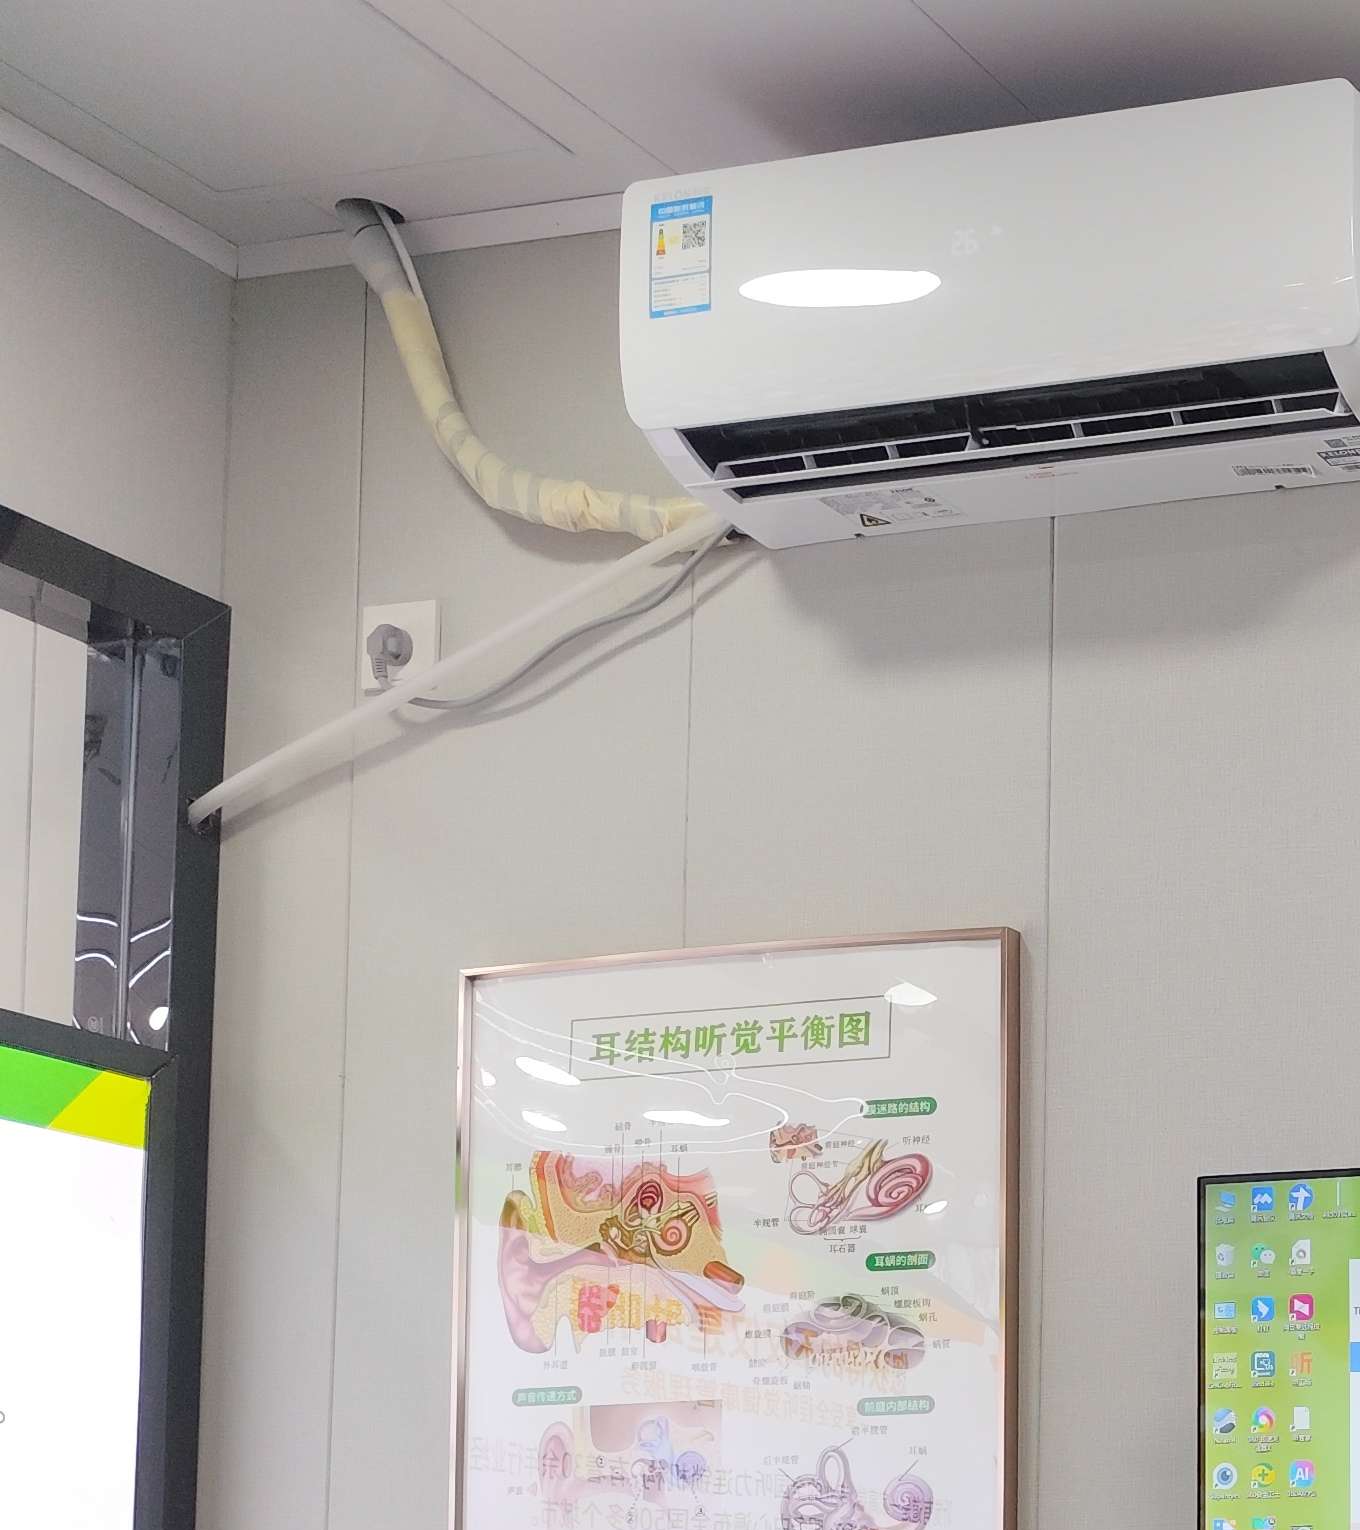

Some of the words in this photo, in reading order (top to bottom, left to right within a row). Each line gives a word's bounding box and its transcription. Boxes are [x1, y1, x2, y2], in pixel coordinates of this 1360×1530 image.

[588, 1010, 872, 1067] 耳结构听觉平衡图
